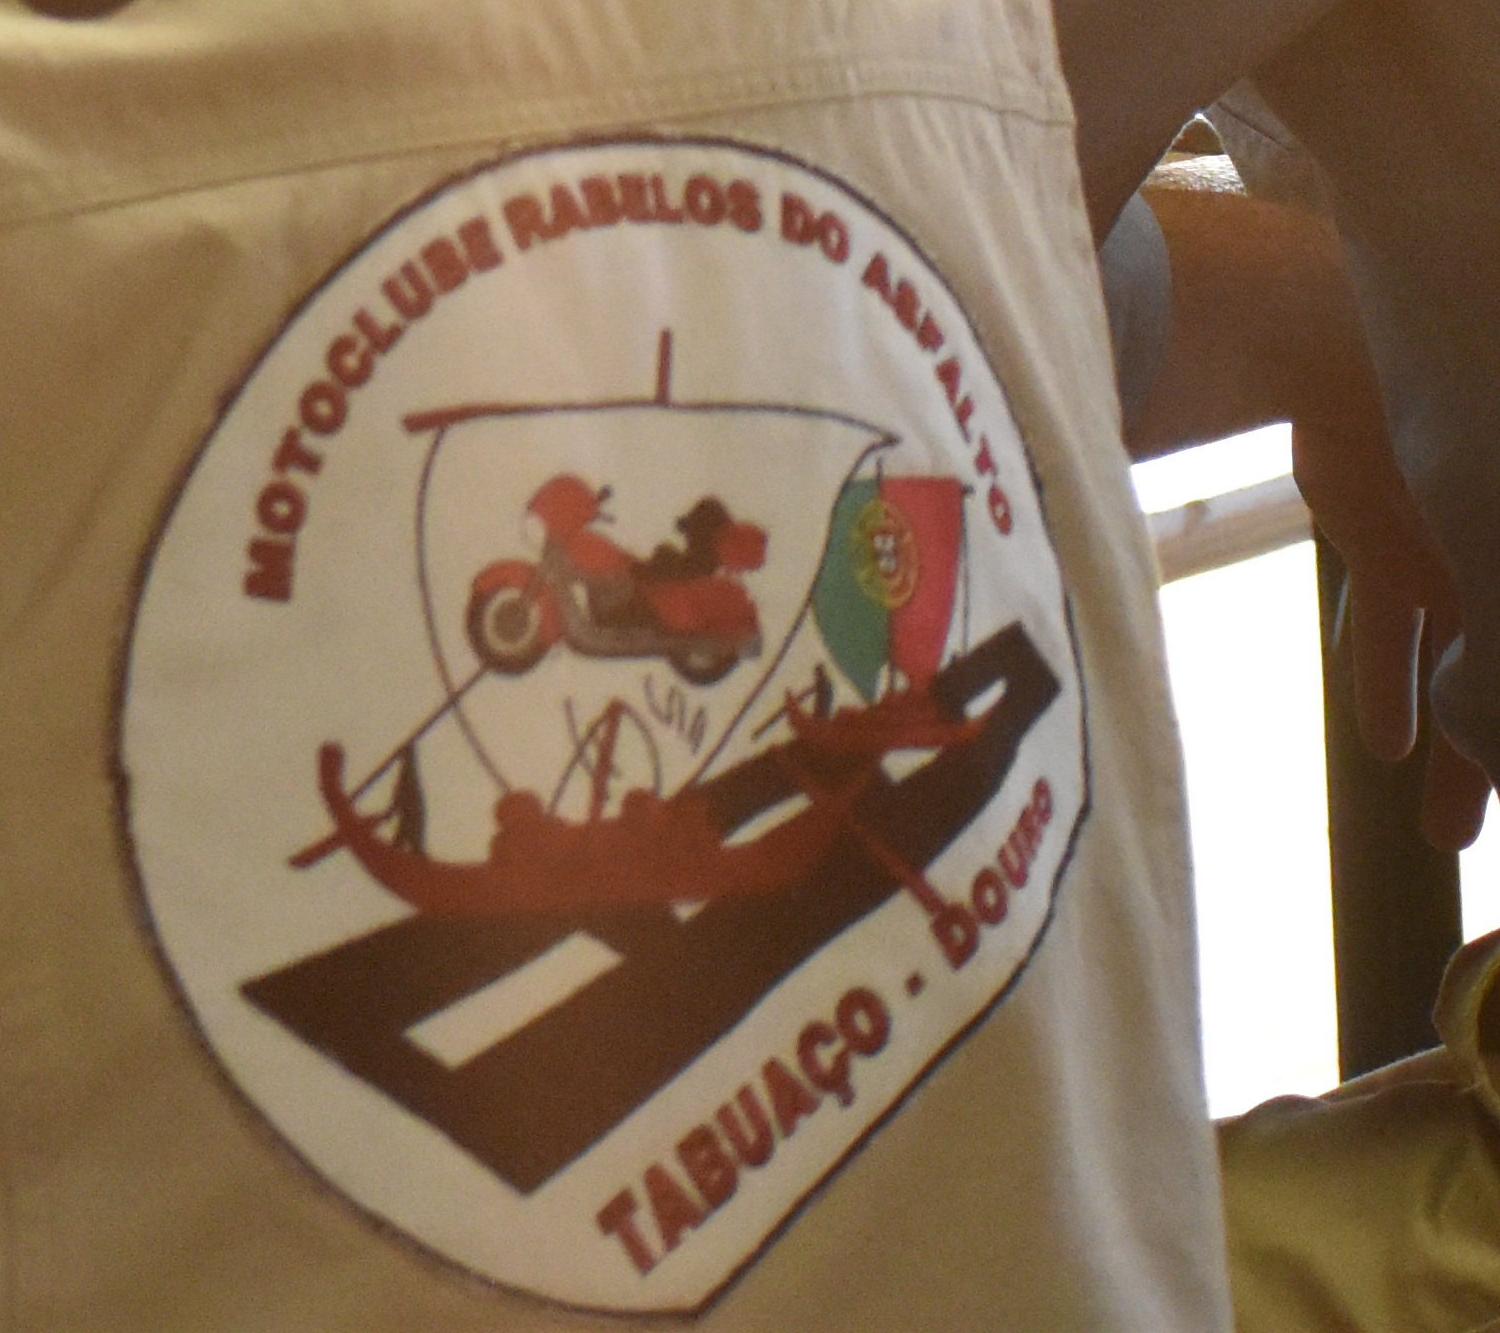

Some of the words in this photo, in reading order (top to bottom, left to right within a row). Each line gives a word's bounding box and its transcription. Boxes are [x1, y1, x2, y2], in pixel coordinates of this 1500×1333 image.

[243, 215, 505, 604] MOTOCLUBE
[503, 173, 762, 252] RABELOS
[779, 191, 851, 265] DO
[860, 251, 1013, 537] ASFALTO
[595, 986, 890, 1278] TABUAÇO
[927, 776, 1053, 971] DOURO
